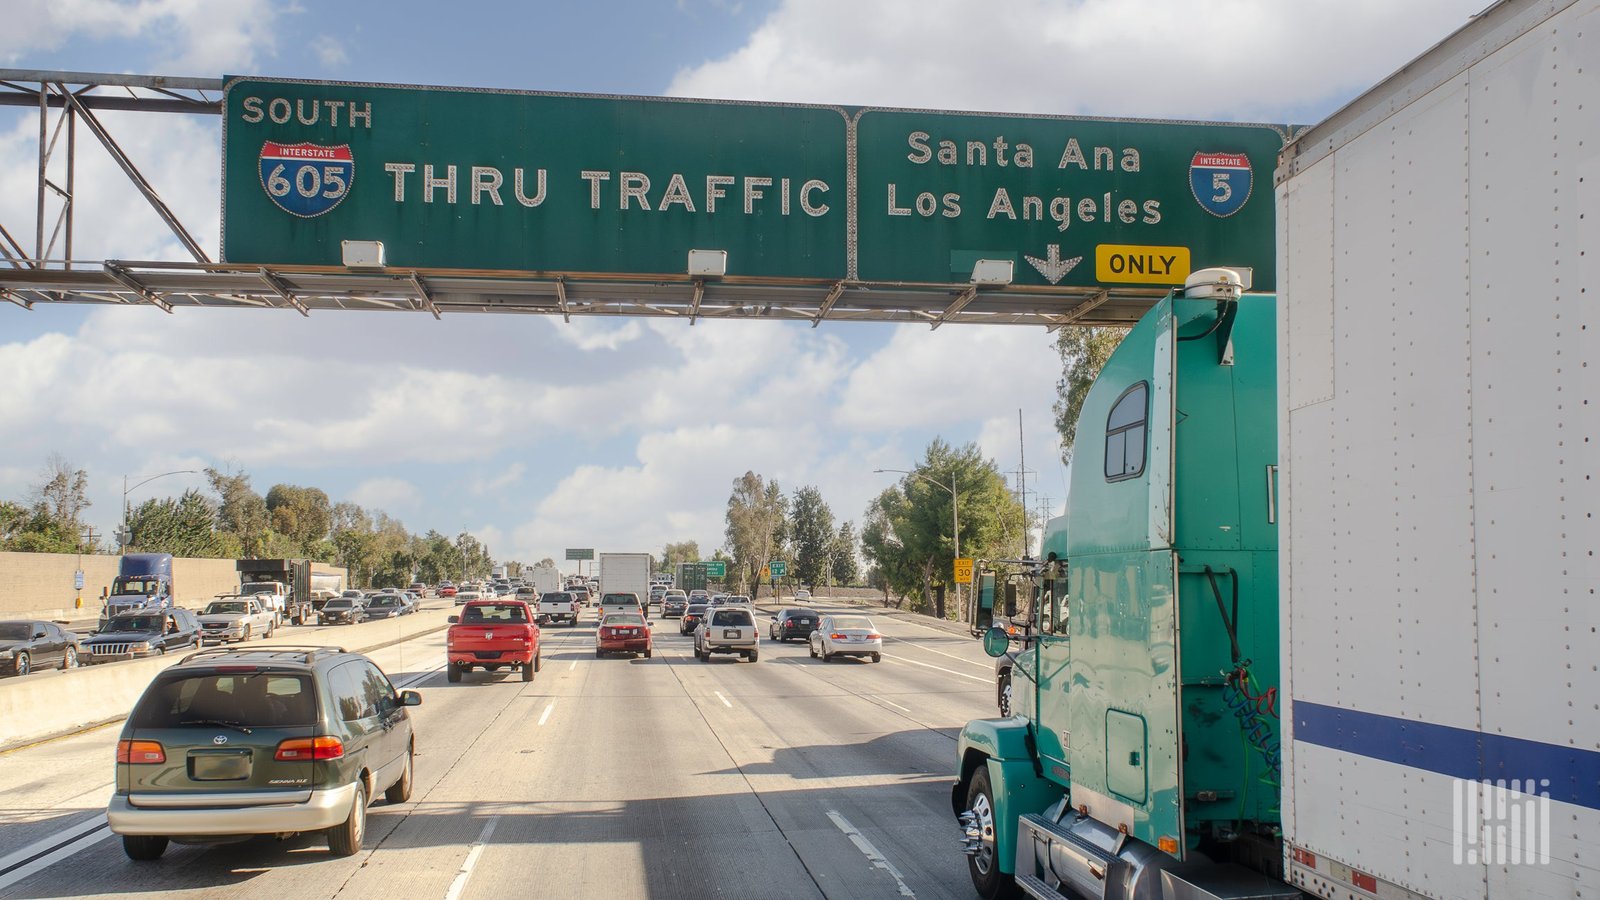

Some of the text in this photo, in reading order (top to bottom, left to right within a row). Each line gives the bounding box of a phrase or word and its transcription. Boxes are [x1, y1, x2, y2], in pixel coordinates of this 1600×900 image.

[242, 96, 372, 129] SOUTH
[279, 148, 335, 158] INTERSTATE
[907, 131, 1140, 172] Santa Ana
[1200, 157, 1241, 166] INTERSTATE
[267, 164, 346, 199] 605
[384, 163, 830, 217] THRU TRAFFIC
[1212, 173, 1232, 203] 5
[887, 183, 1162, 232] Los Angeles
[1109, 253, 1177, 275] ONLY
[958, 568, 971, 577] 30
